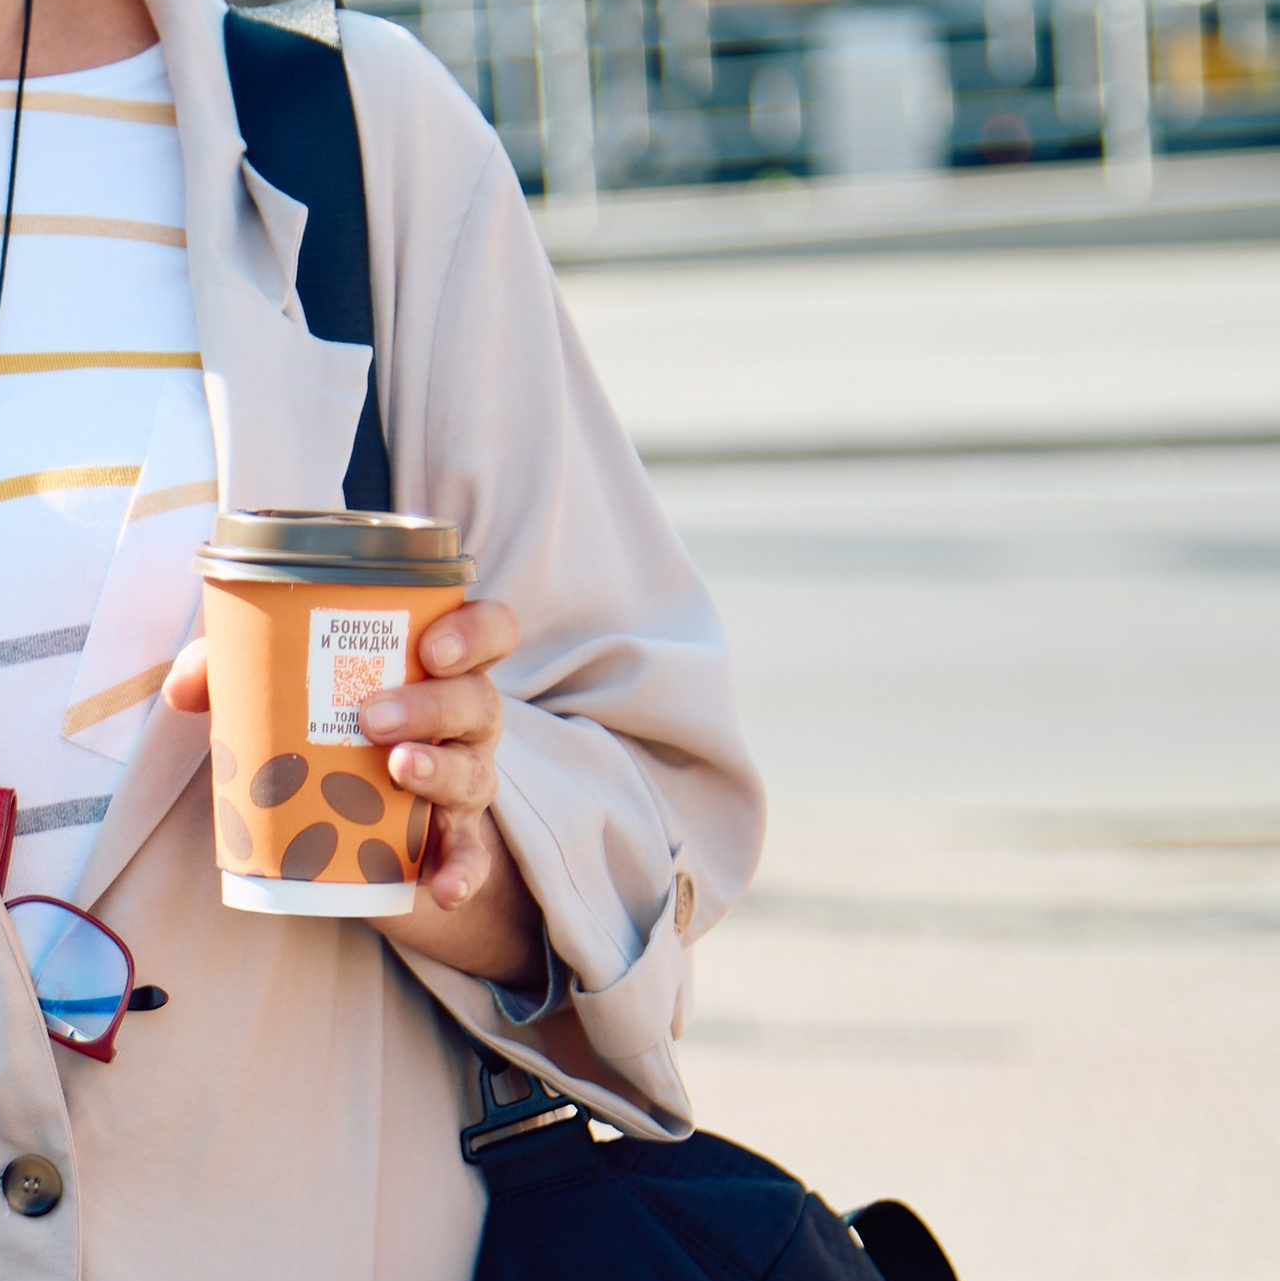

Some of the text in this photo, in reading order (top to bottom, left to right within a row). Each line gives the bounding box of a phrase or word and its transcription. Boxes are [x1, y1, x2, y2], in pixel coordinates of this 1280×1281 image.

[330, 619, 393, 635] БОНУСЫ
[321, 634, 399, 652] И СКИДКИ
[309, 721, 363, 735] В ПРИЛО
